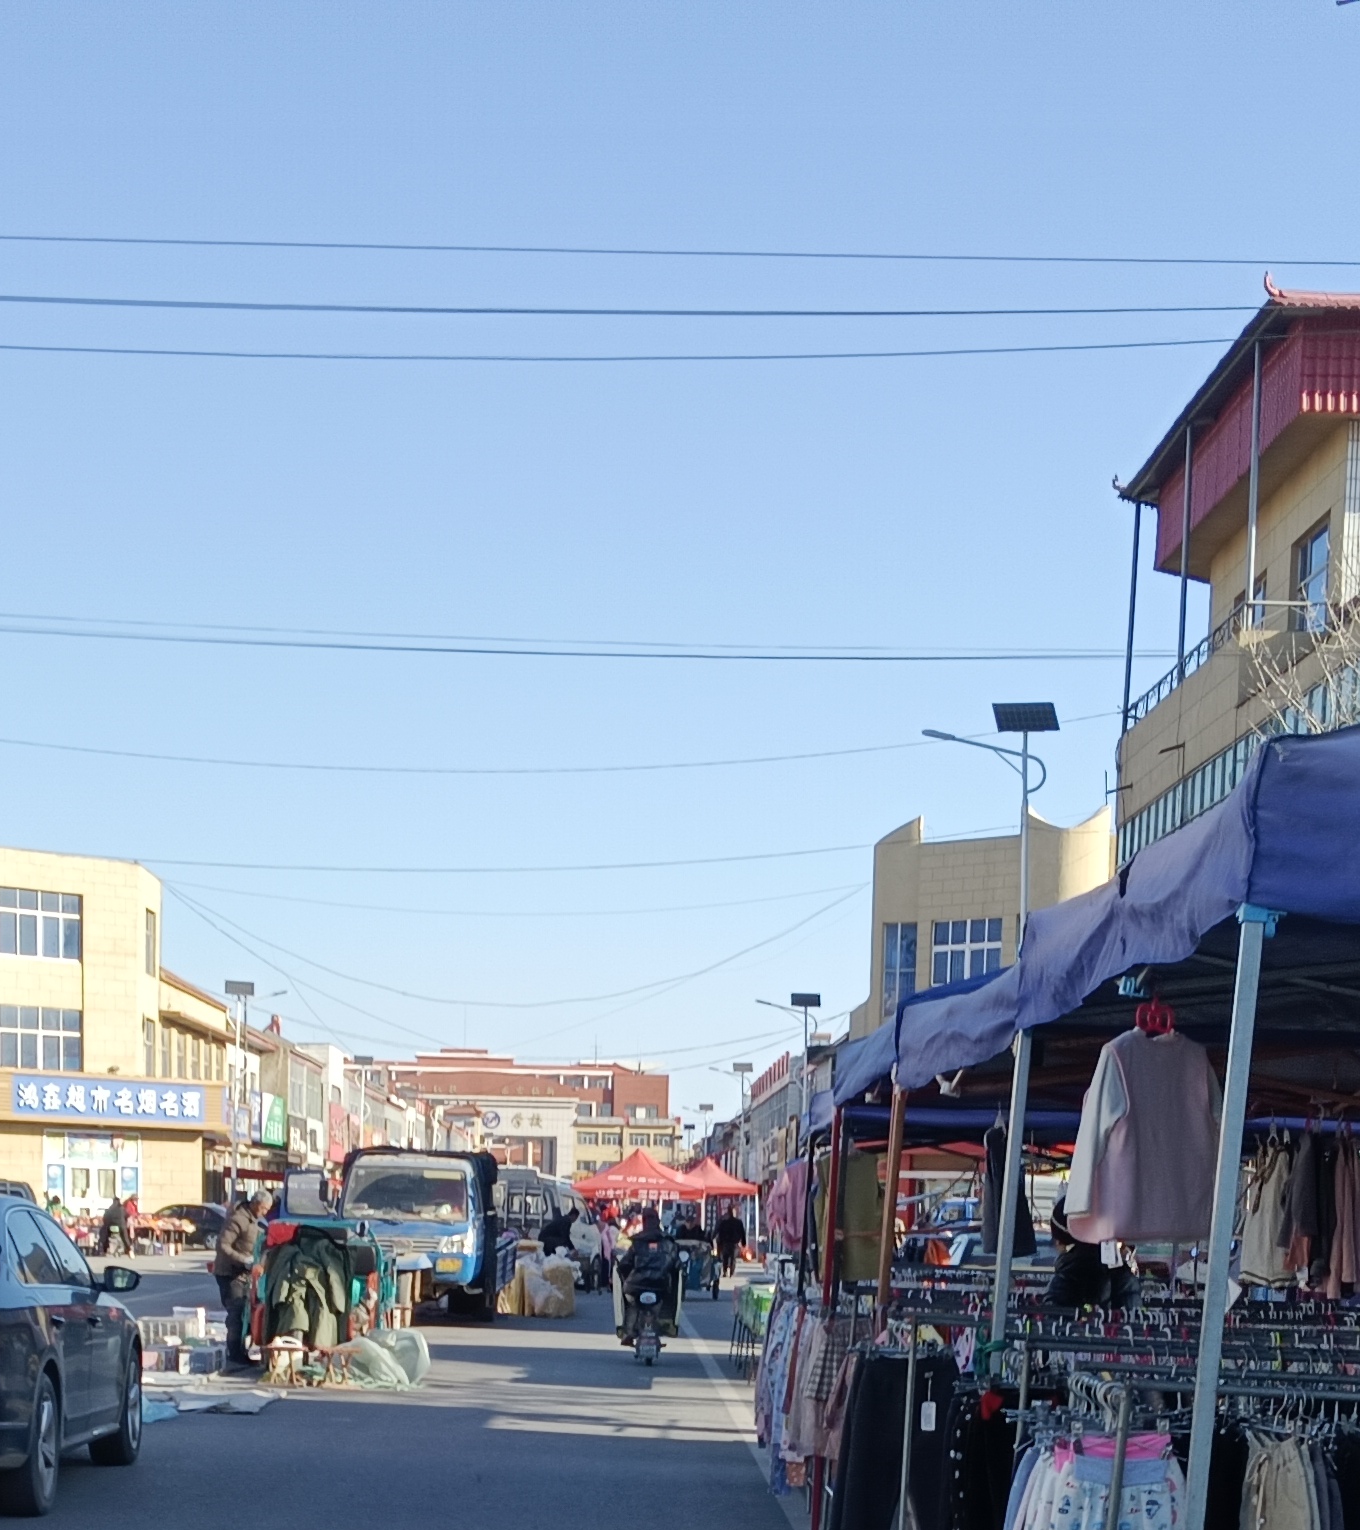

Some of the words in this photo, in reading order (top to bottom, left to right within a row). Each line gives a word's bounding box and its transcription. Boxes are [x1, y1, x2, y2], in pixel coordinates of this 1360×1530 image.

[17, 1081, 201, 1119] 鸿鑫超市名烟名酒
